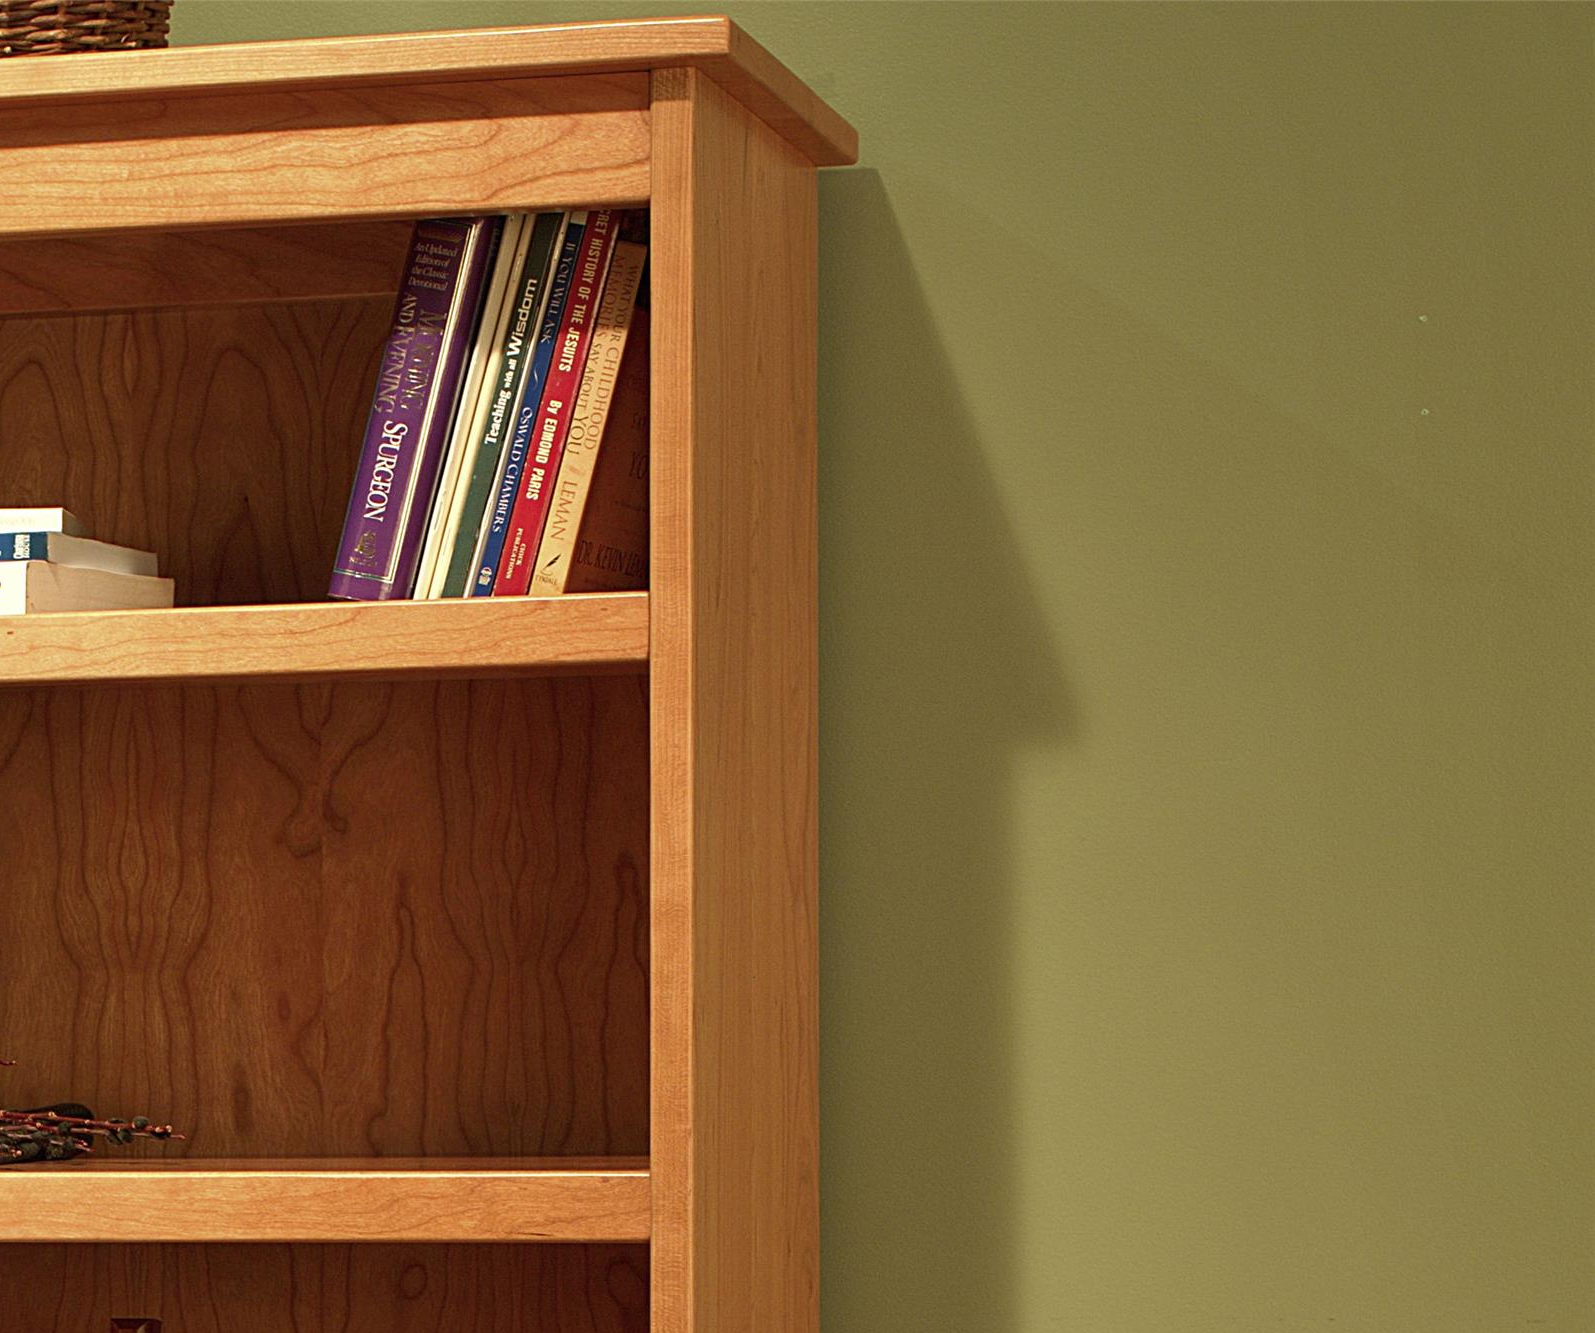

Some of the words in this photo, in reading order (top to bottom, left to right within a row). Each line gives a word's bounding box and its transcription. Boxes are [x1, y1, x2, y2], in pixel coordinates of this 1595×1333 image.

[582, 238, 604, 284] HISTORY
[398, 294, 417, 323] AND
[571, 303, 587, 324] THE
[577, 286, 592, 300] OF
[597, 256, 624, 338] MEMORIES
[507, 279, 538, 356] Wisdom
[540, 320, 555, 344] ASK
[614, 305, 630, 342] YOUR
[374, 326, 416, 414] EVENING
[558, 326, 580, 372] JESUITS
[588, 342, 601, 366] SAY
[504, 370, 516, 388] with
[577, 367, 594, 410] ABOUT
[584, 346, 620, 450] CHILDHOOD
[484, 388, 511, 445] Teaching
[510, 406, 533, 462] OSWALD
[567, 416, 588, 456] YOU
[535, 418, 558, 464] EDMOND
[364, 420, 408, 523] SPURGEON
[526, 467, 546, 500] PARIS
[492, 464, 518, 533] CHAMBERS
[550, 480, 578, 541] LEMAN
[505, 528, 524, 580] PUBLICATIONS
